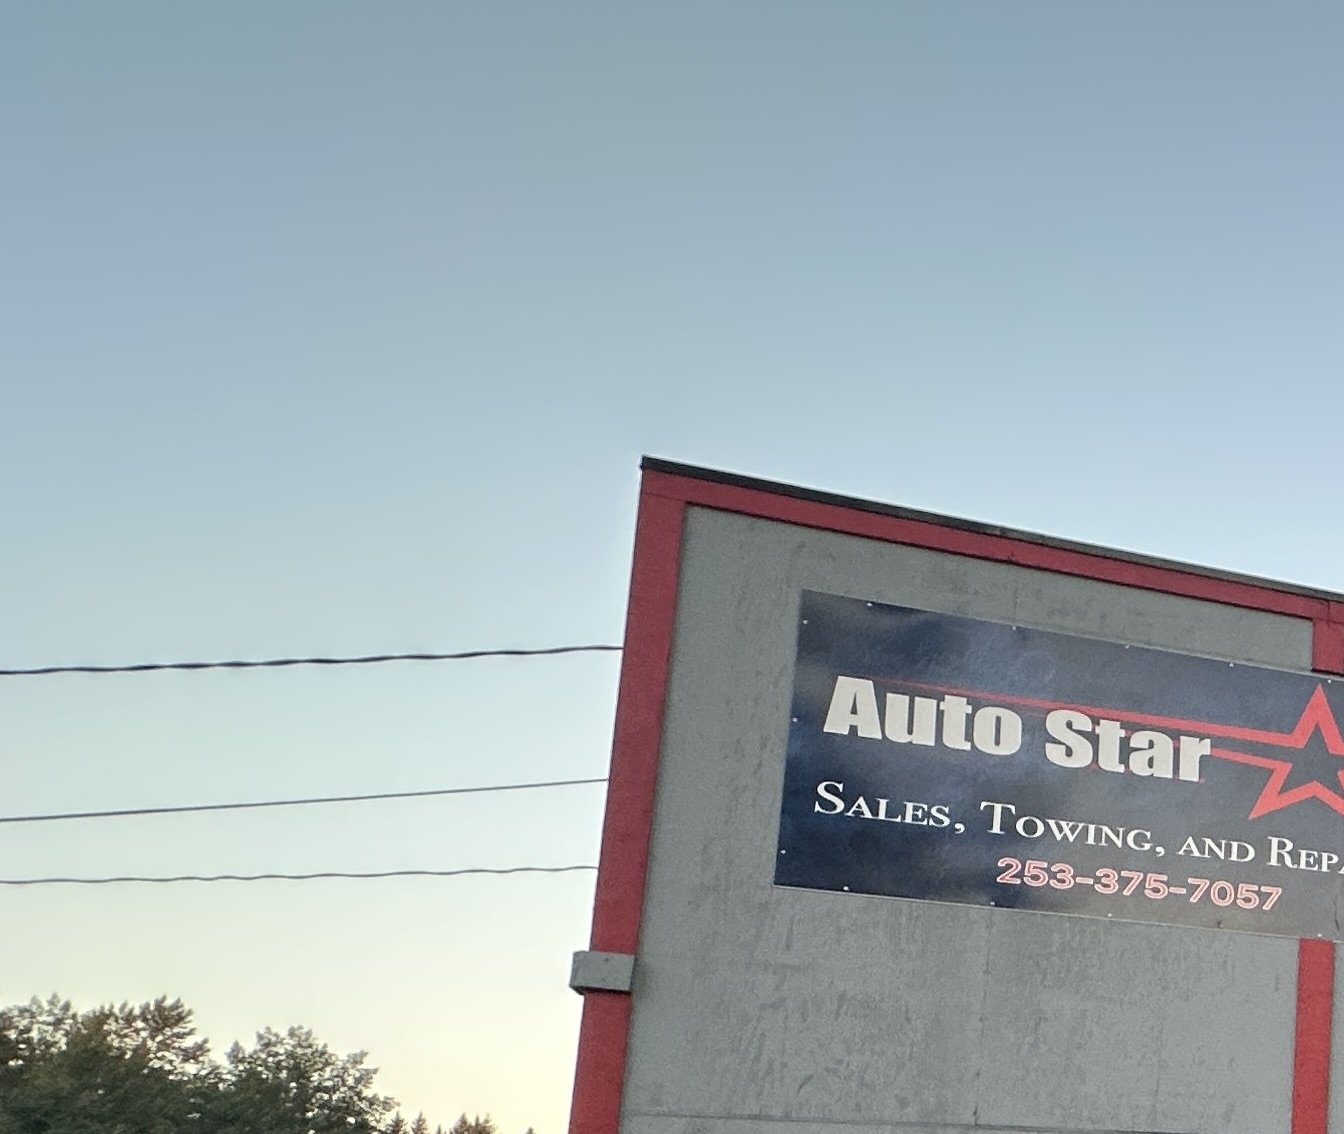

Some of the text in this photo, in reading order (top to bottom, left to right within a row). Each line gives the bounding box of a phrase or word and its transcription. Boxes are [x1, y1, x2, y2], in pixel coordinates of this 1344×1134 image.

[823, 675, 1213, 783] Auto Star
[995, 856, 1283, 912] 253-375-7057
